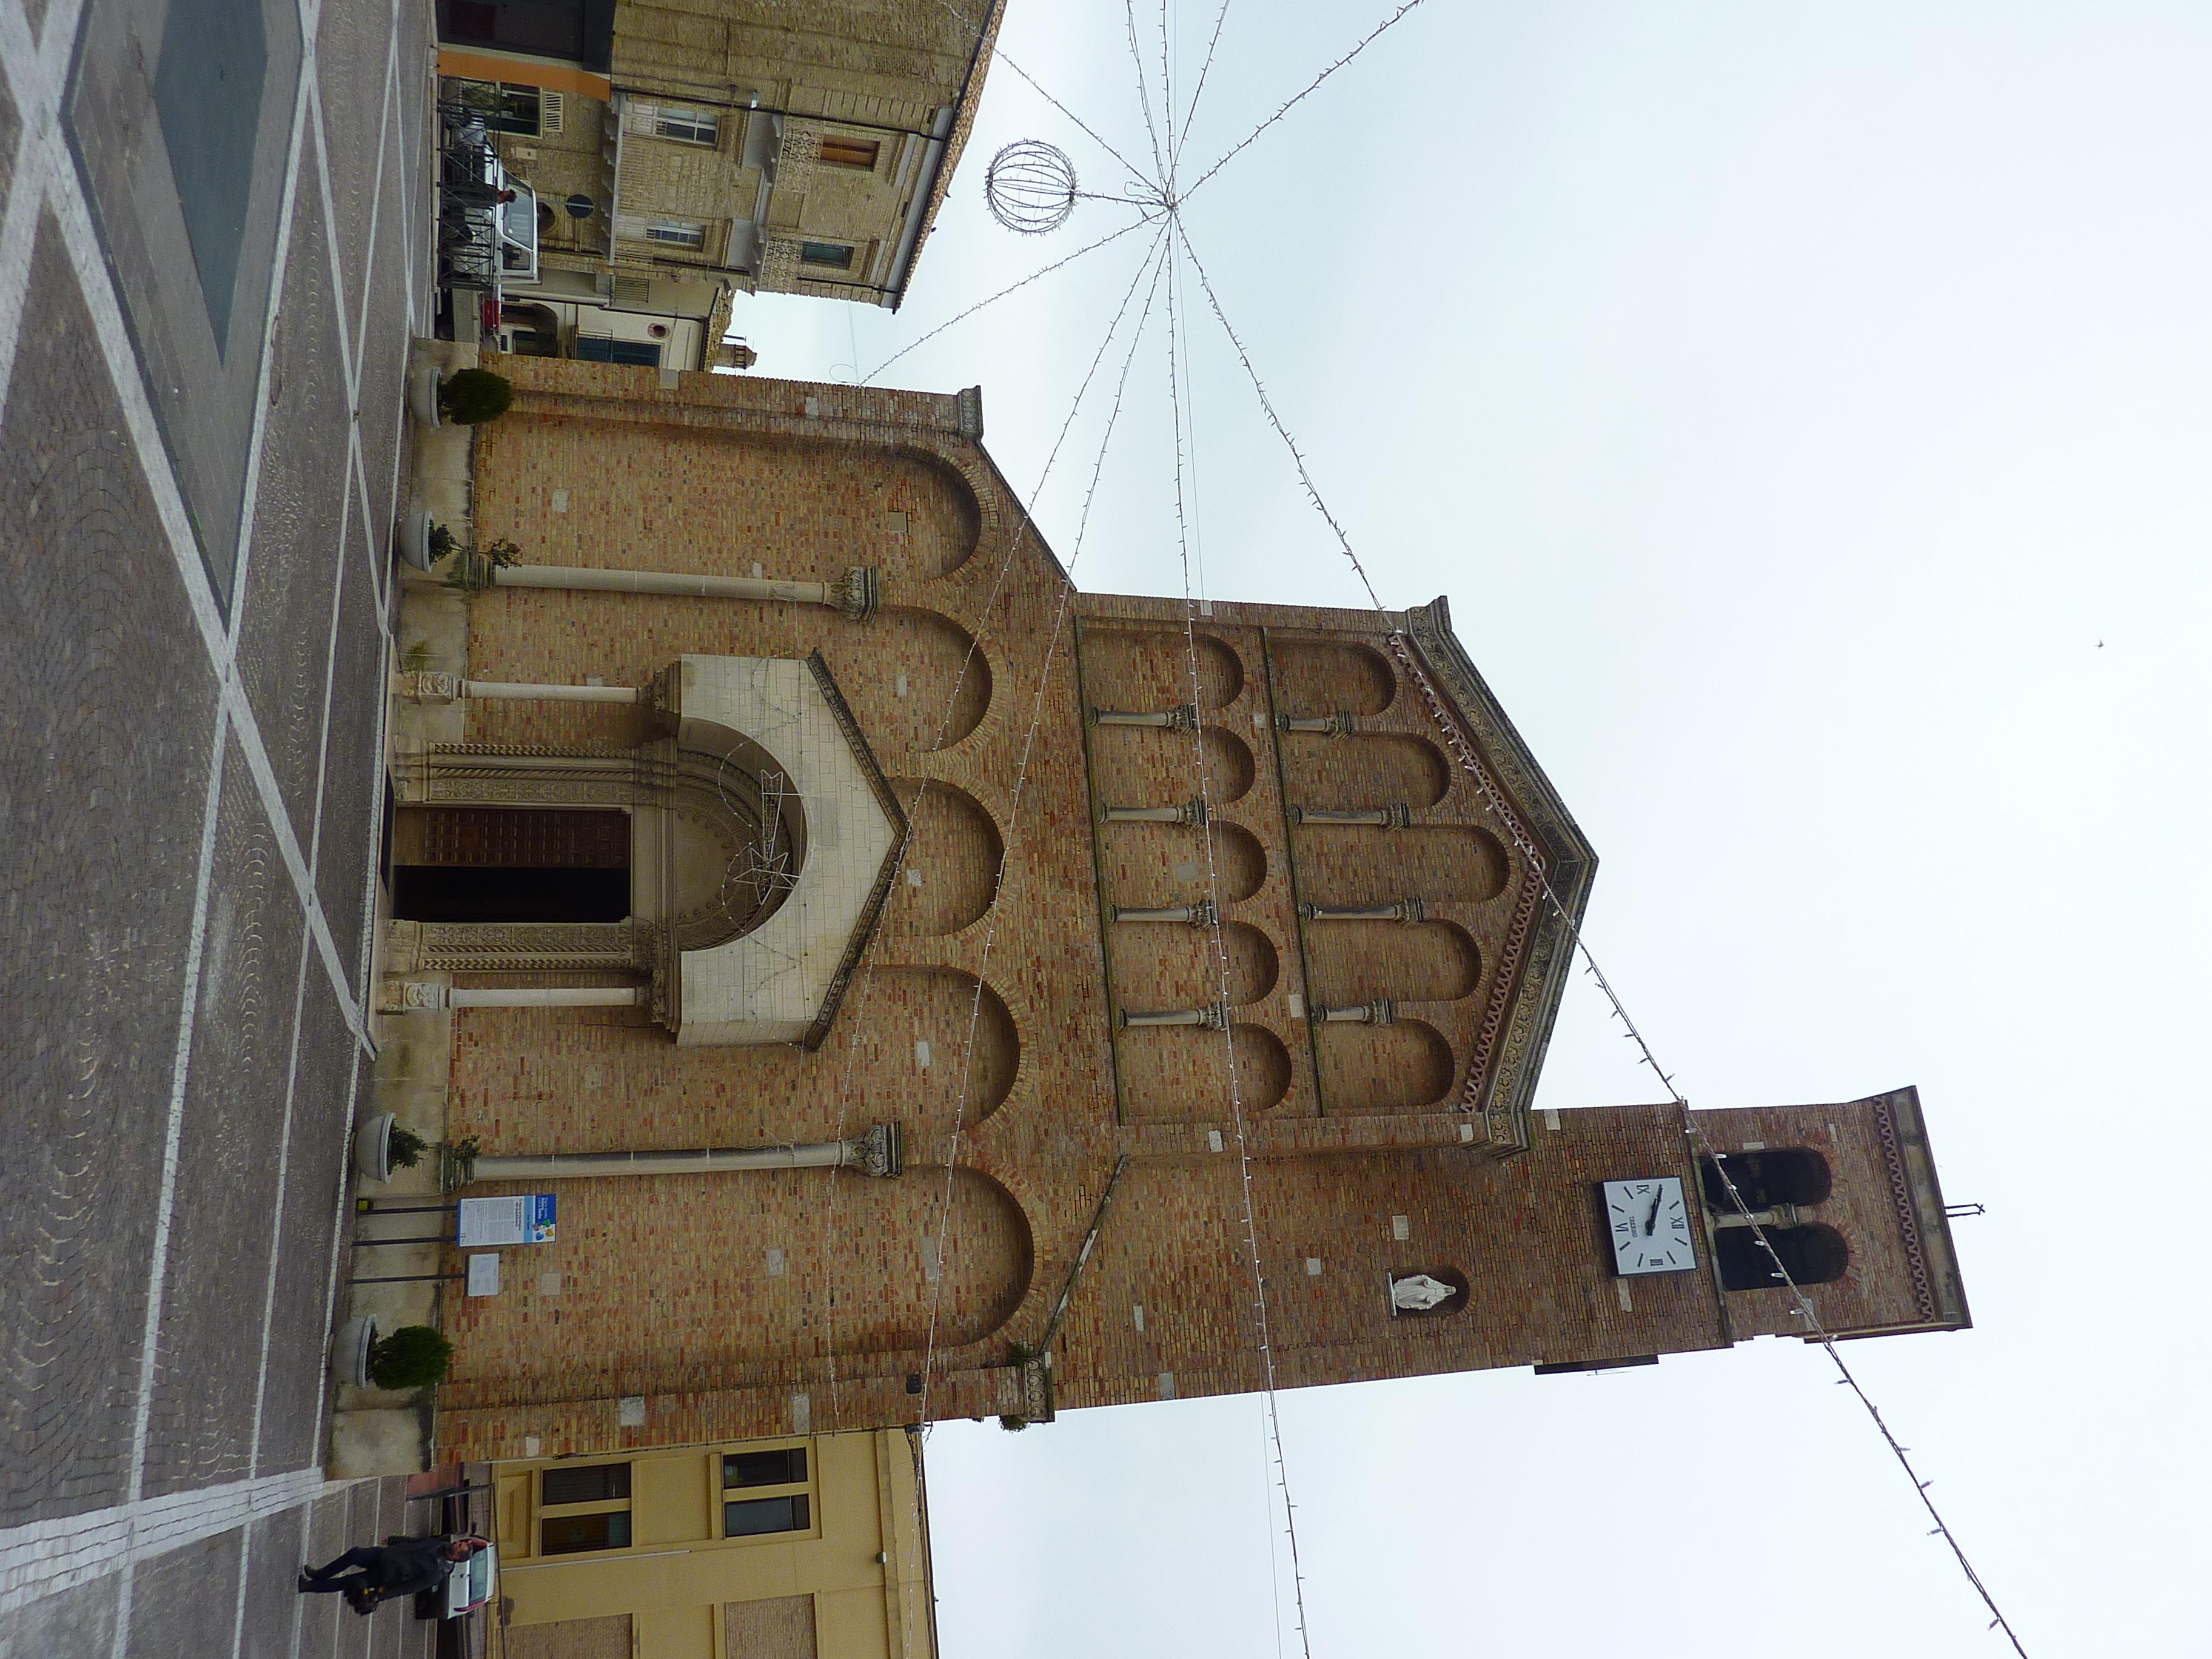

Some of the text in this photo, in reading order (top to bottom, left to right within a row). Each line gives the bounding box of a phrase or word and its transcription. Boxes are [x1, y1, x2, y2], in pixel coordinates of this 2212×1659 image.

[1636, 1184, 1651, 1195] IX
[1615, 1222, 1629, 1232] VI
[1670, 1216, 1684, 1229] XII
